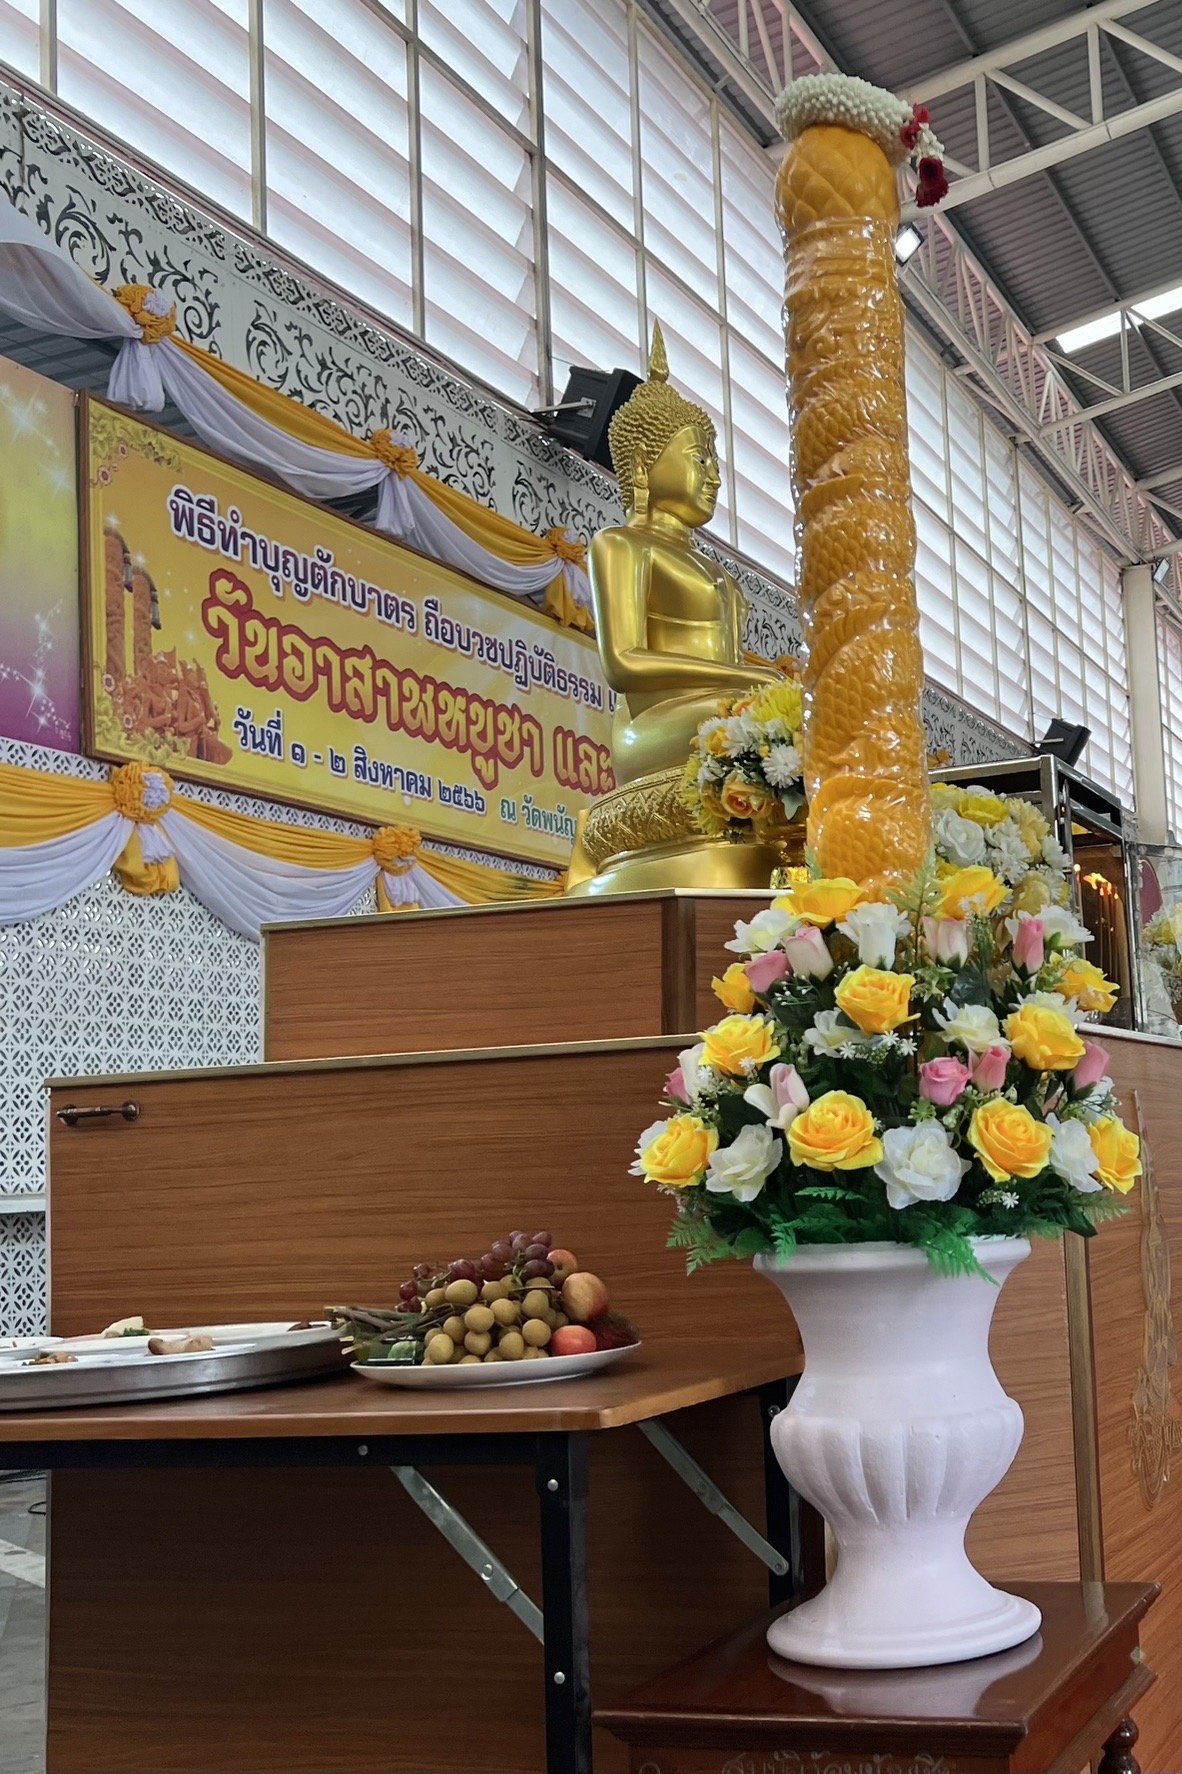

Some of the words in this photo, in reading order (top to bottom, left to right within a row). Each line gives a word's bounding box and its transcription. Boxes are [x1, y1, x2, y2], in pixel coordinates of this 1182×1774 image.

[168, 486, 416, 633] พิธีทำบุญตักบาตร
[424, 597, 603, 708] ถือบวชปฏิบัติธรรม
[204, 572, 543, 788] วันอาสาฬหบูชา
[555, 727, 615, 795] และ
[232, 707, 284, 757] วันที่
[290, 741, 306, 765] ๑
[330, 748, 346, 774] ๒
[354, 745, 432, 798] สิงหาคม
[438, 779, 486, 814] ๒๕๖๖
[500, 797, 517, 822] ณ
